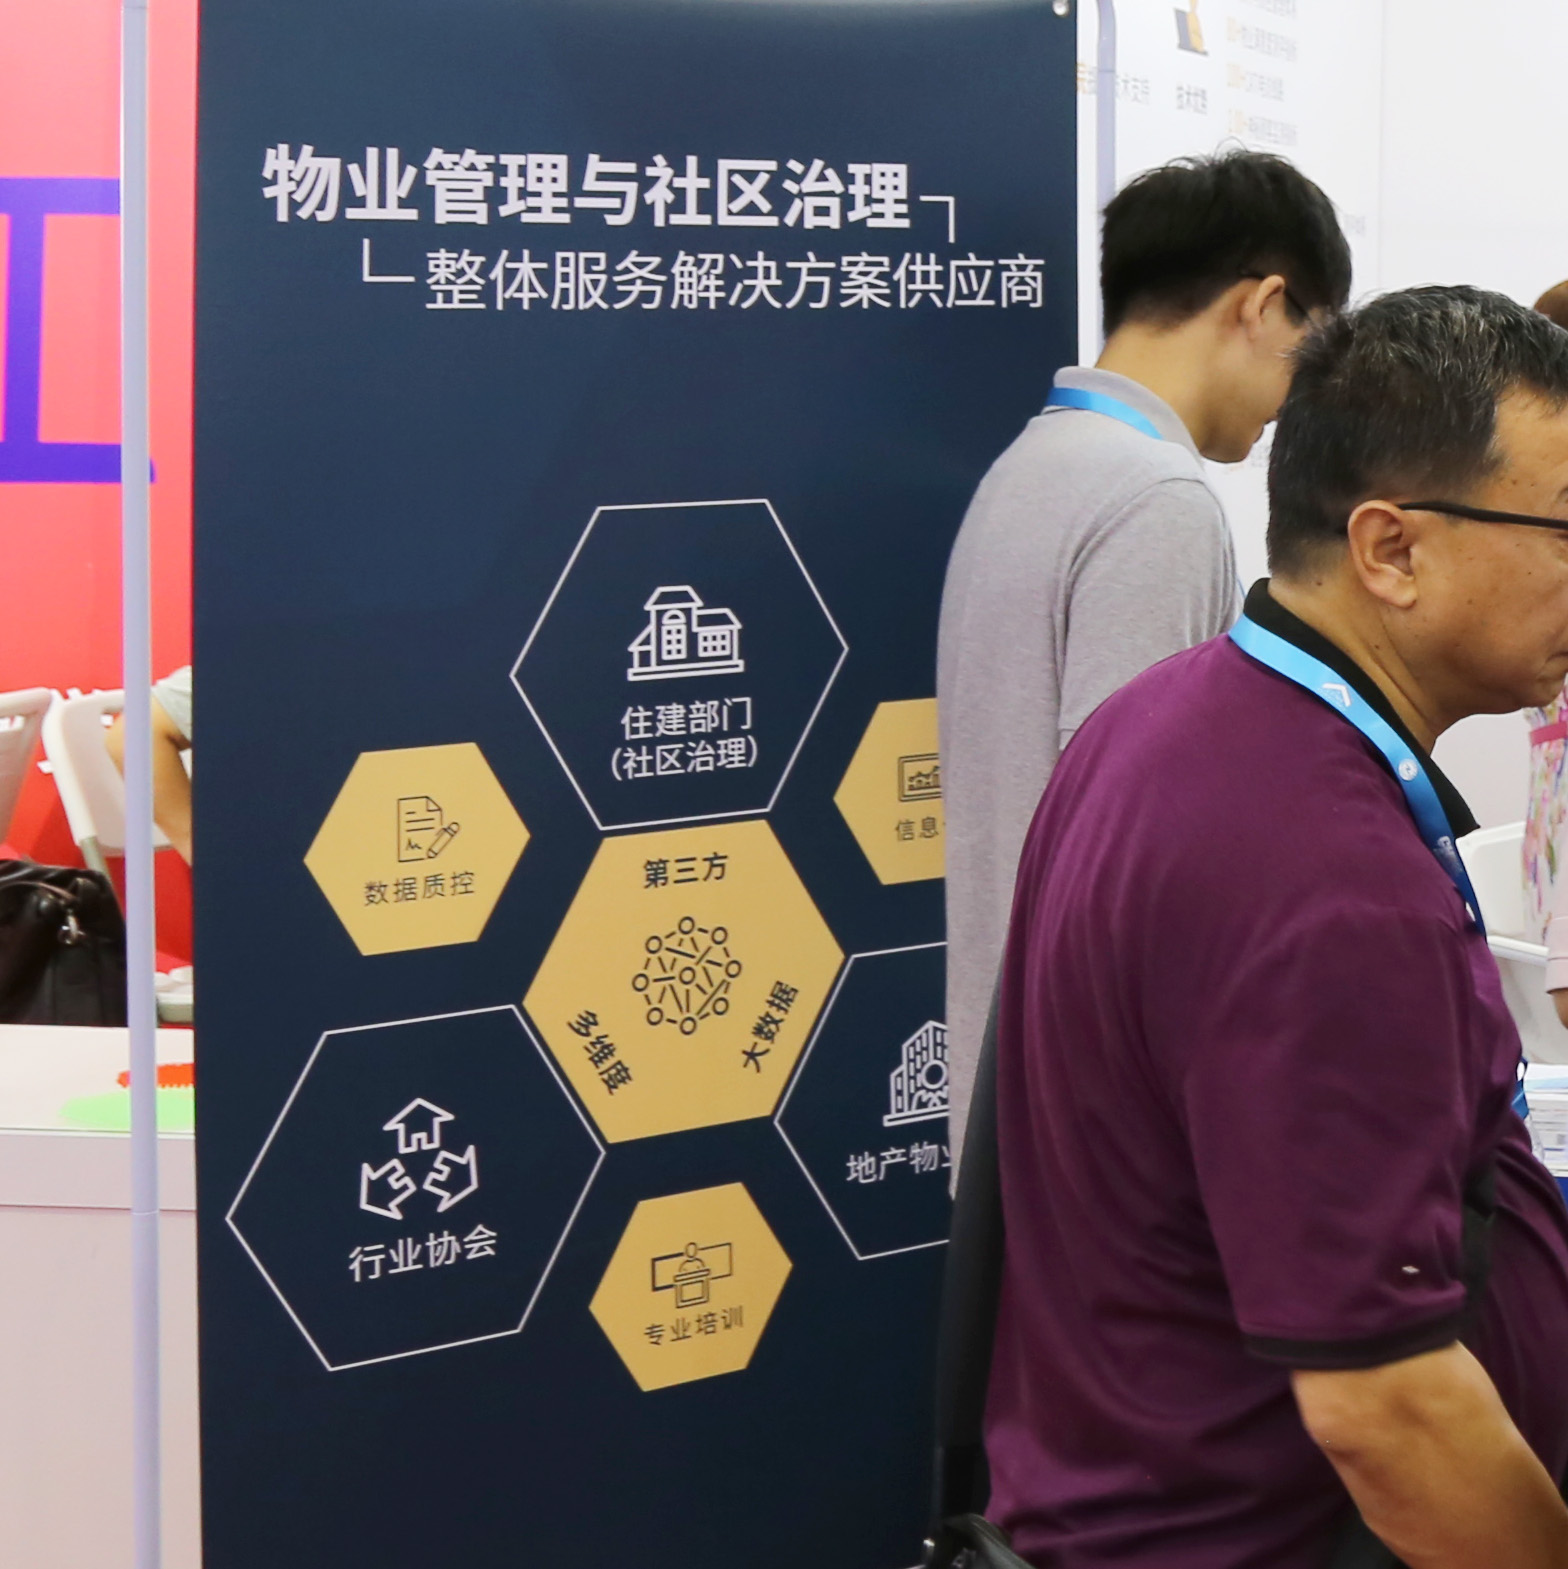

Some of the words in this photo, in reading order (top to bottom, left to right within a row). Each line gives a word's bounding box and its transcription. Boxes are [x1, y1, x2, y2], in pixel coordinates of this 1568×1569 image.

[262, 143, 911, 231] 物业管理与社区治理
[426, 248, 1045, 311] 整体服务解决方案供应商
[620, 696, 753, 742] 住建部门
[610, 738, 760, 782] (社区治理)
[894, 815, 946, 843] 信息
[362, 869, 477, 908] 数据质控
[642, 851, 730, 890] 第三方
[741, 979, 800, 1073] 大数据
[566, 1007, 636, 1096] 多维度
[348, 1223, 499, 1284] 行业协会
[642, 1304, 746, 1348] 专业培训
